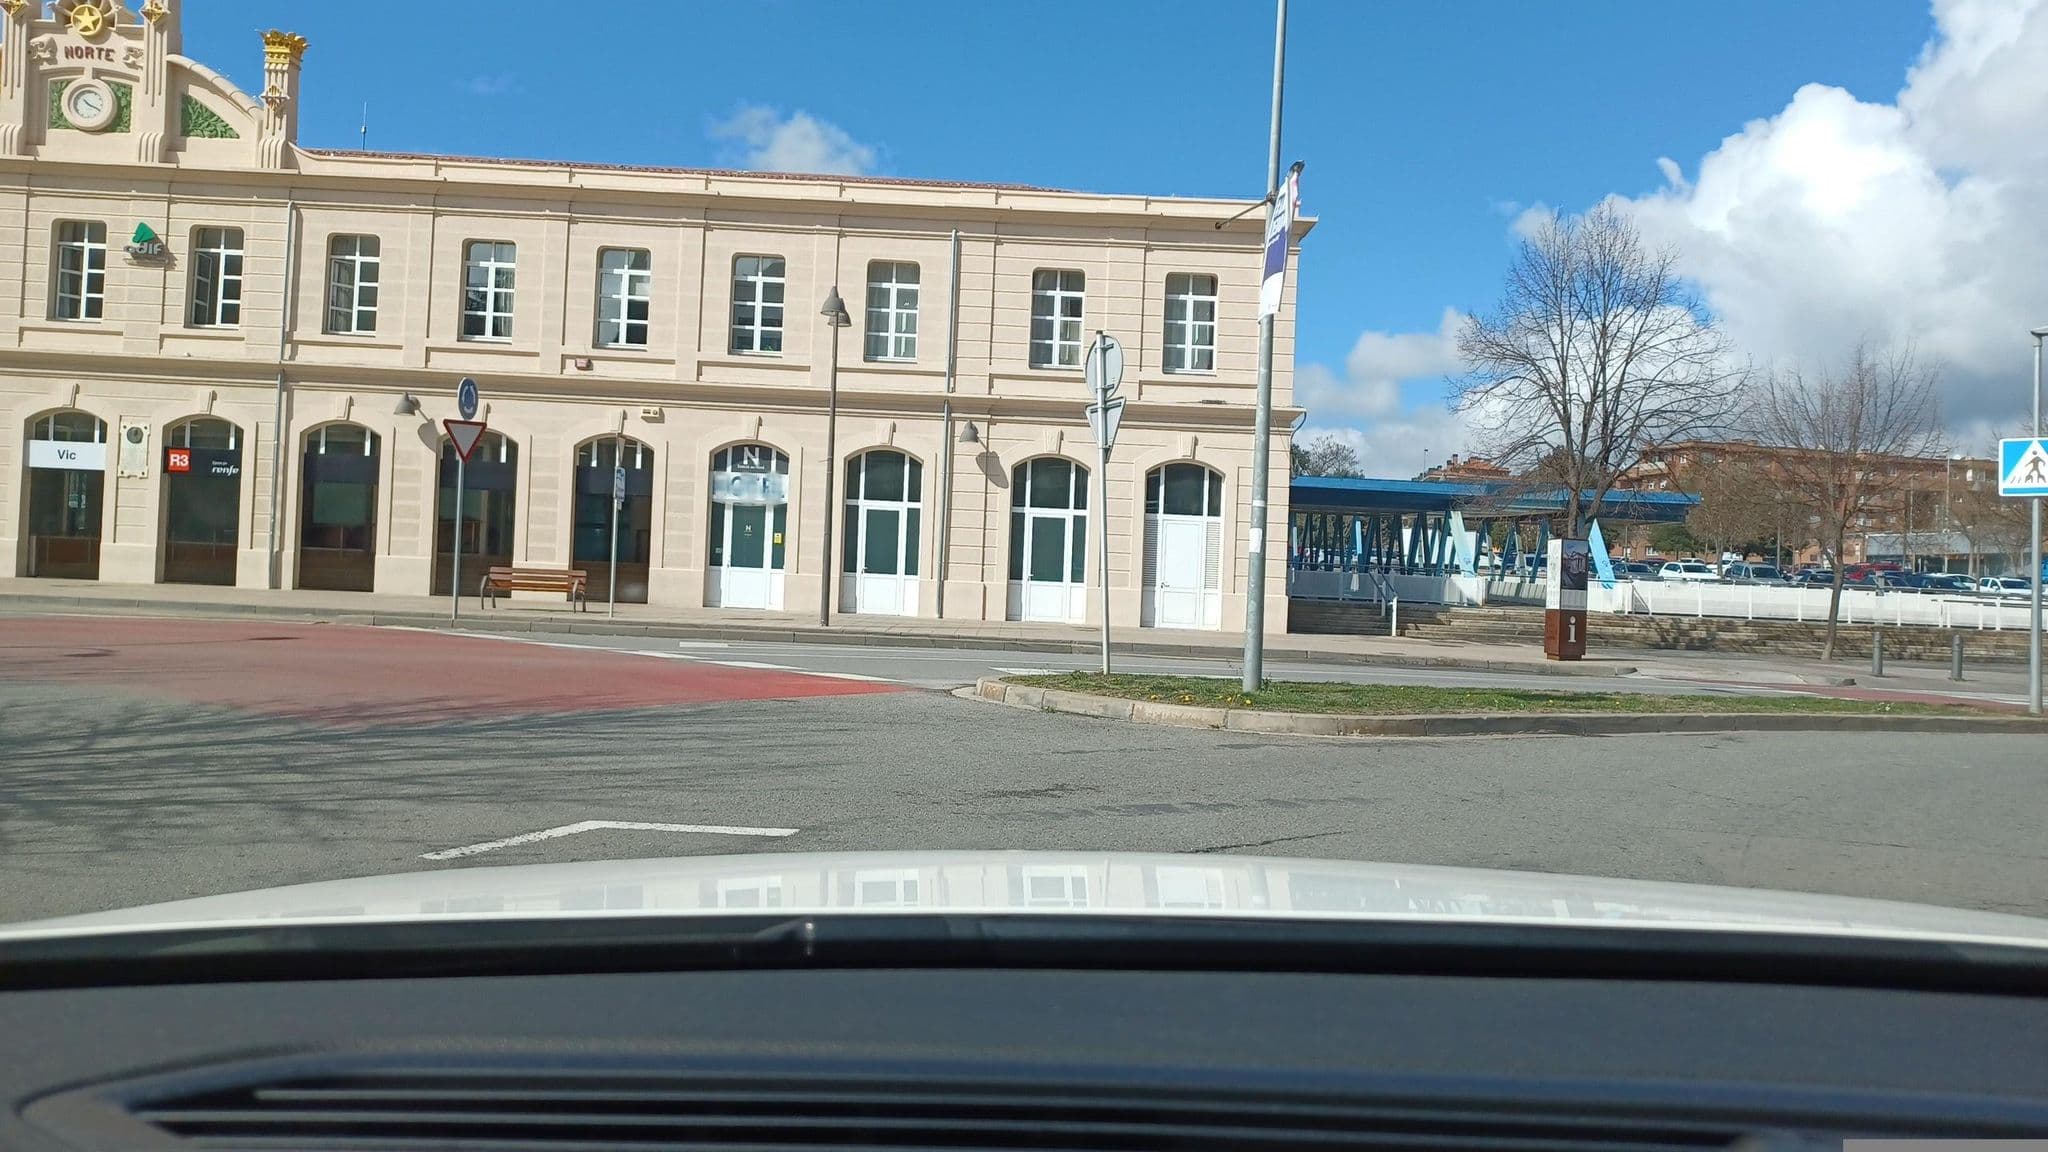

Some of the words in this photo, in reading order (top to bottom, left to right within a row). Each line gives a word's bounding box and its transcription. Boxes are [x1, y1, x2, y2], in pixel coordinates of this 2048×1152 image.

[64, 45, 116, 63] NORTE
[57, 448, 76, 460] Vic
[169, 454, 189, 467] R3
[743, 446, 760, 466] N
[211, 465, 240, 476] renfe
